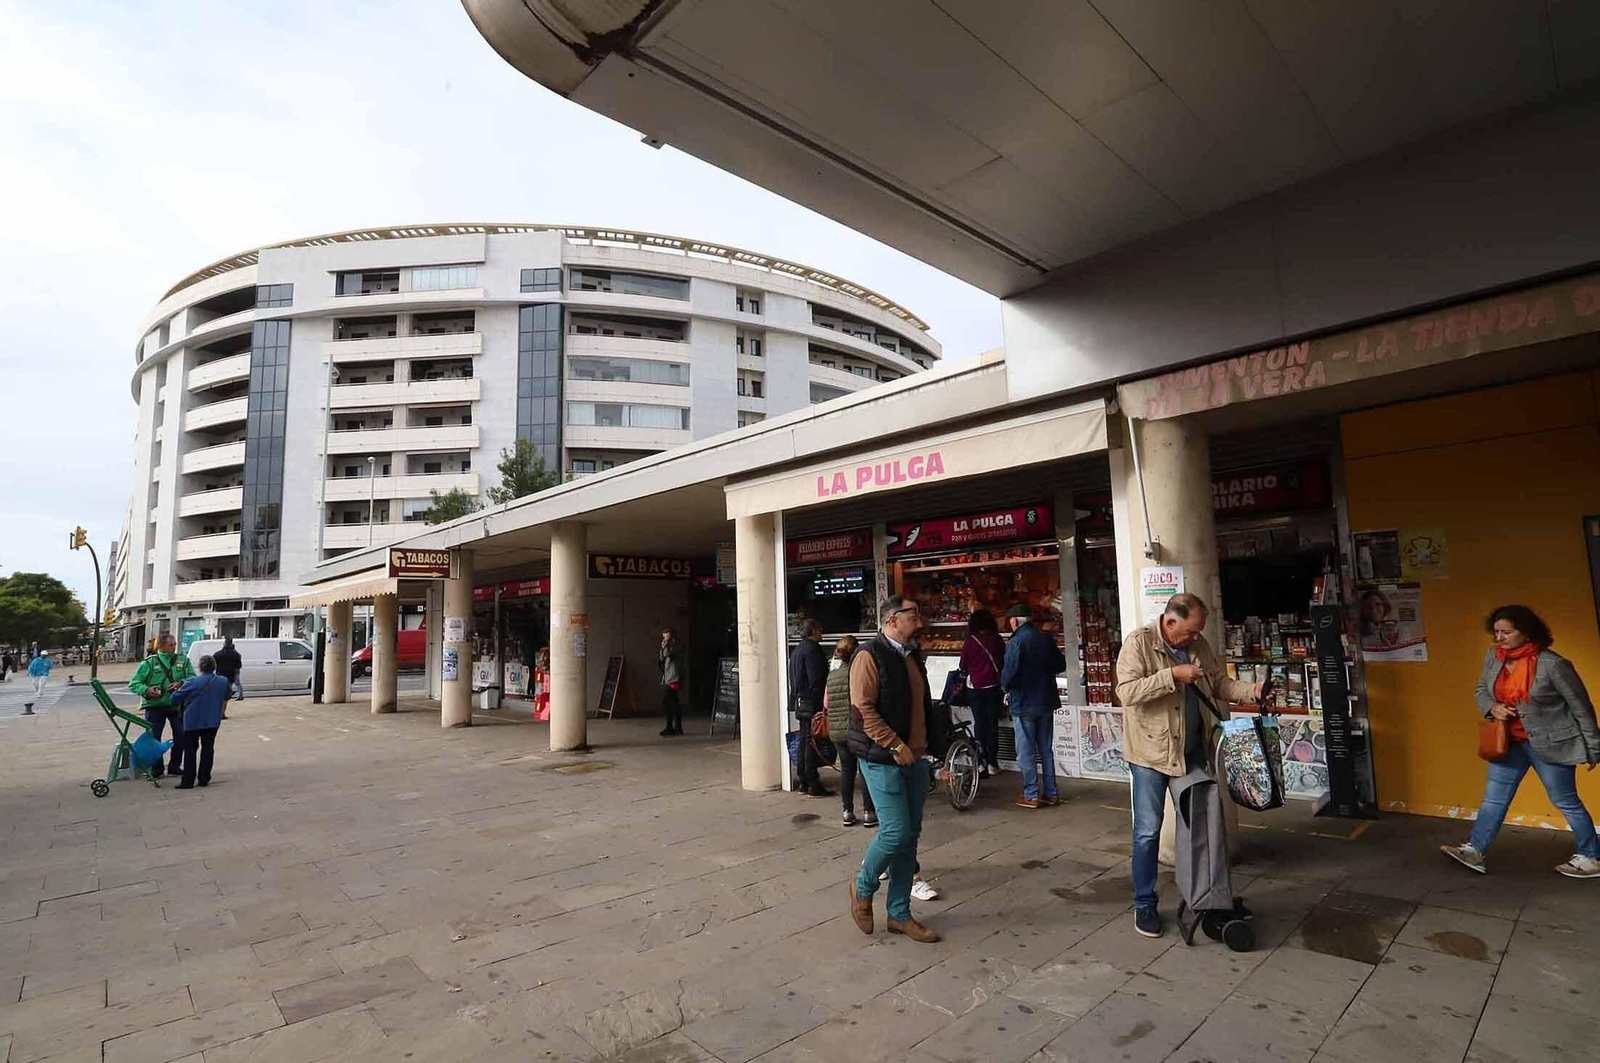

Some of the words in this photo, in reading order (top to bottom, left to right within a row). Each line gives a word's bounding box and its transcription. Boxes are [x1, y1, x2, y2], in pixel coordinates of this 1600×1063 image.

[1408, 299, 1556, 353] TIENDA
[1243, 361, 1326, 399] VERA
[817, 472, 847, 498] LA
[856, 452, 946, 491] PULGA
[953, 520, 969, 532] LA
[972, 513, 1014, 530] PULGA
[826, 536, 850, 550] EXPRESS
[951, 533, 963, 543] Pan
[406, 552, 449, 565] TABACOS
[616, 557, 692, 574] TABACOS
[1148, 572, 1173, 584] ZOCO
